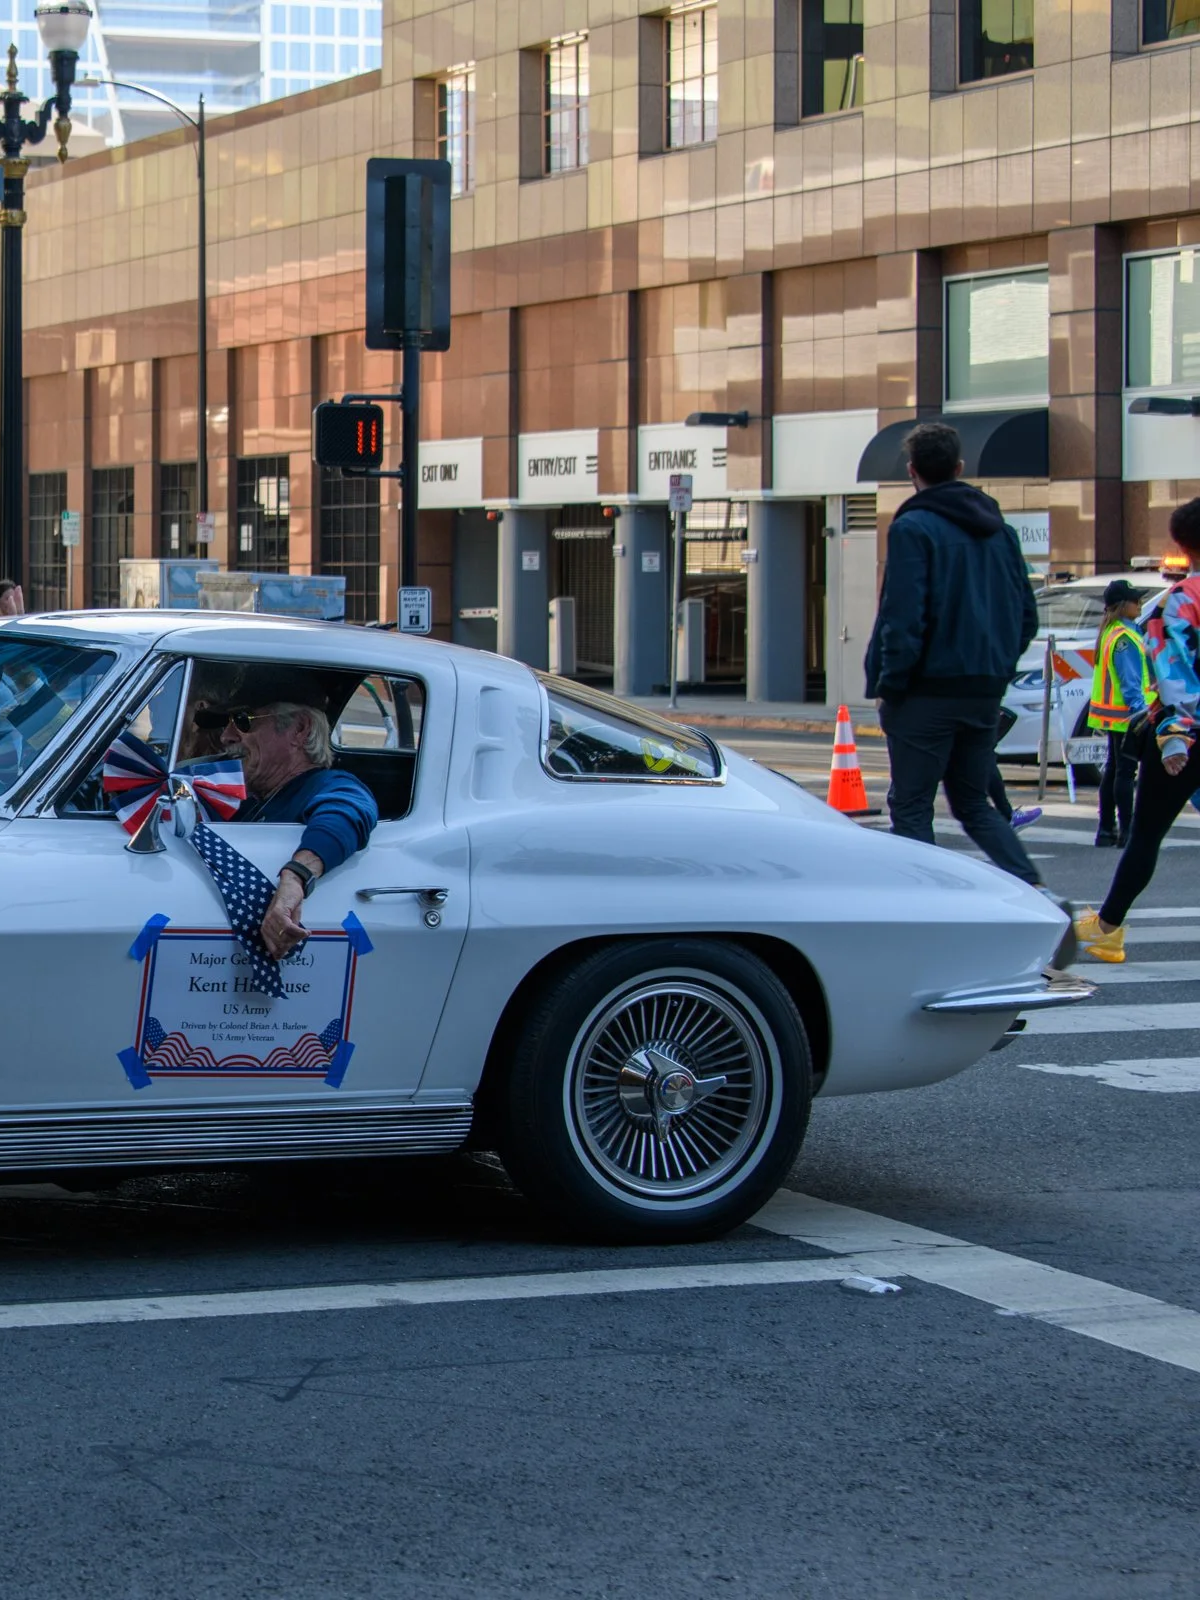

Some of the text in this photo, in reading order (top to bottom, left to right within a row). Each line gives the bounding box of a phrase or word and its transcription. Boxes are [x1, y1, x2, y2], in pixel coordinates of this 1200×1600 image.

[356, 419, 378, 455] 11
[527, 456, 578, 477] ENTRY/EXIT
[648, 449, 697, 470] ENTRANCE
[421, 464, 459, 482] EXIT ONLY
[1064, 688, 1085, 697] 7419
[189, 952, 226, 968] Major
[189, 977, 310, 992] Kent Hiuse
[223, 1004, 271, 1017] US Army
[181, 1022, 308, 1031] Driven by Colonel Brian A. Barlow
[212, 1033, 274, 1044] US Army Veteran
